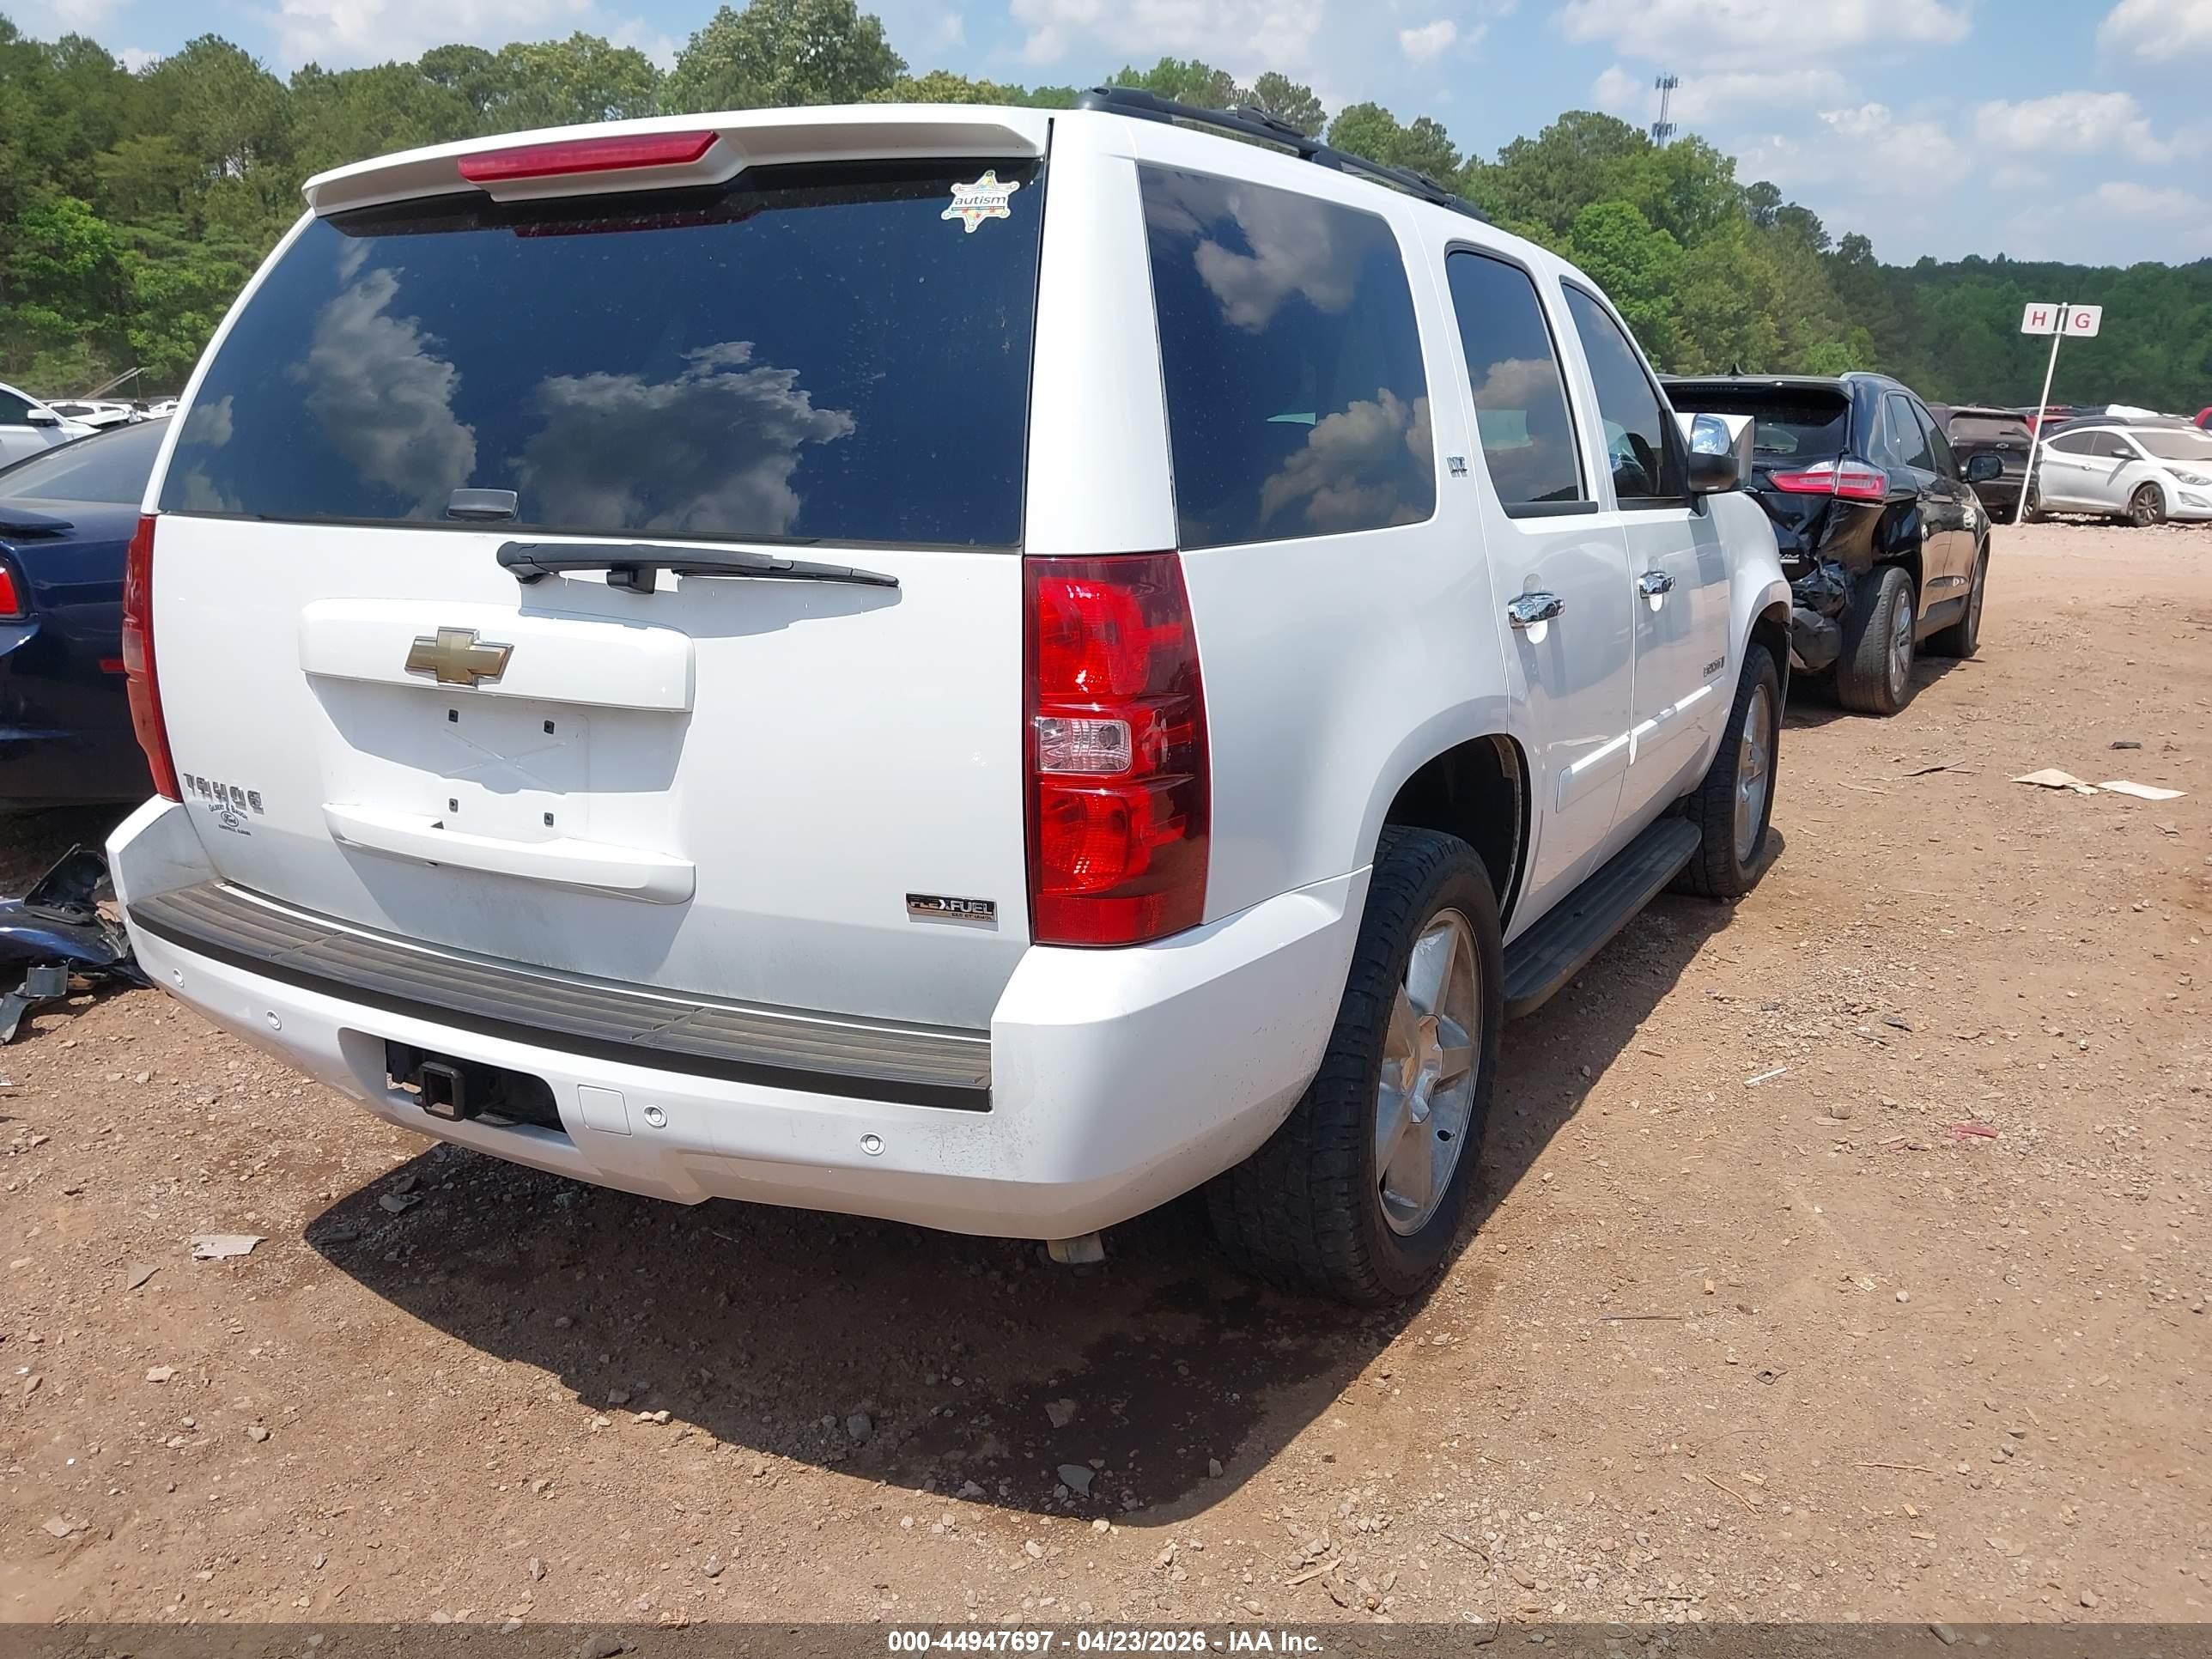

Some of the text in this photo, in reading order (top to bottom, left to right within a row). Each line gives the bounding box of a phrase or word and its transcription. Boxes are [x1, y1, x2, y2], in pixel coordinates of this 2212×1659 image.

[954, 196, 1006, 205] autism
[2032, 311, 2047, 326] H
[2075, 313, 2091, 329] G
[183, 773, 264, 811] TAHOE
